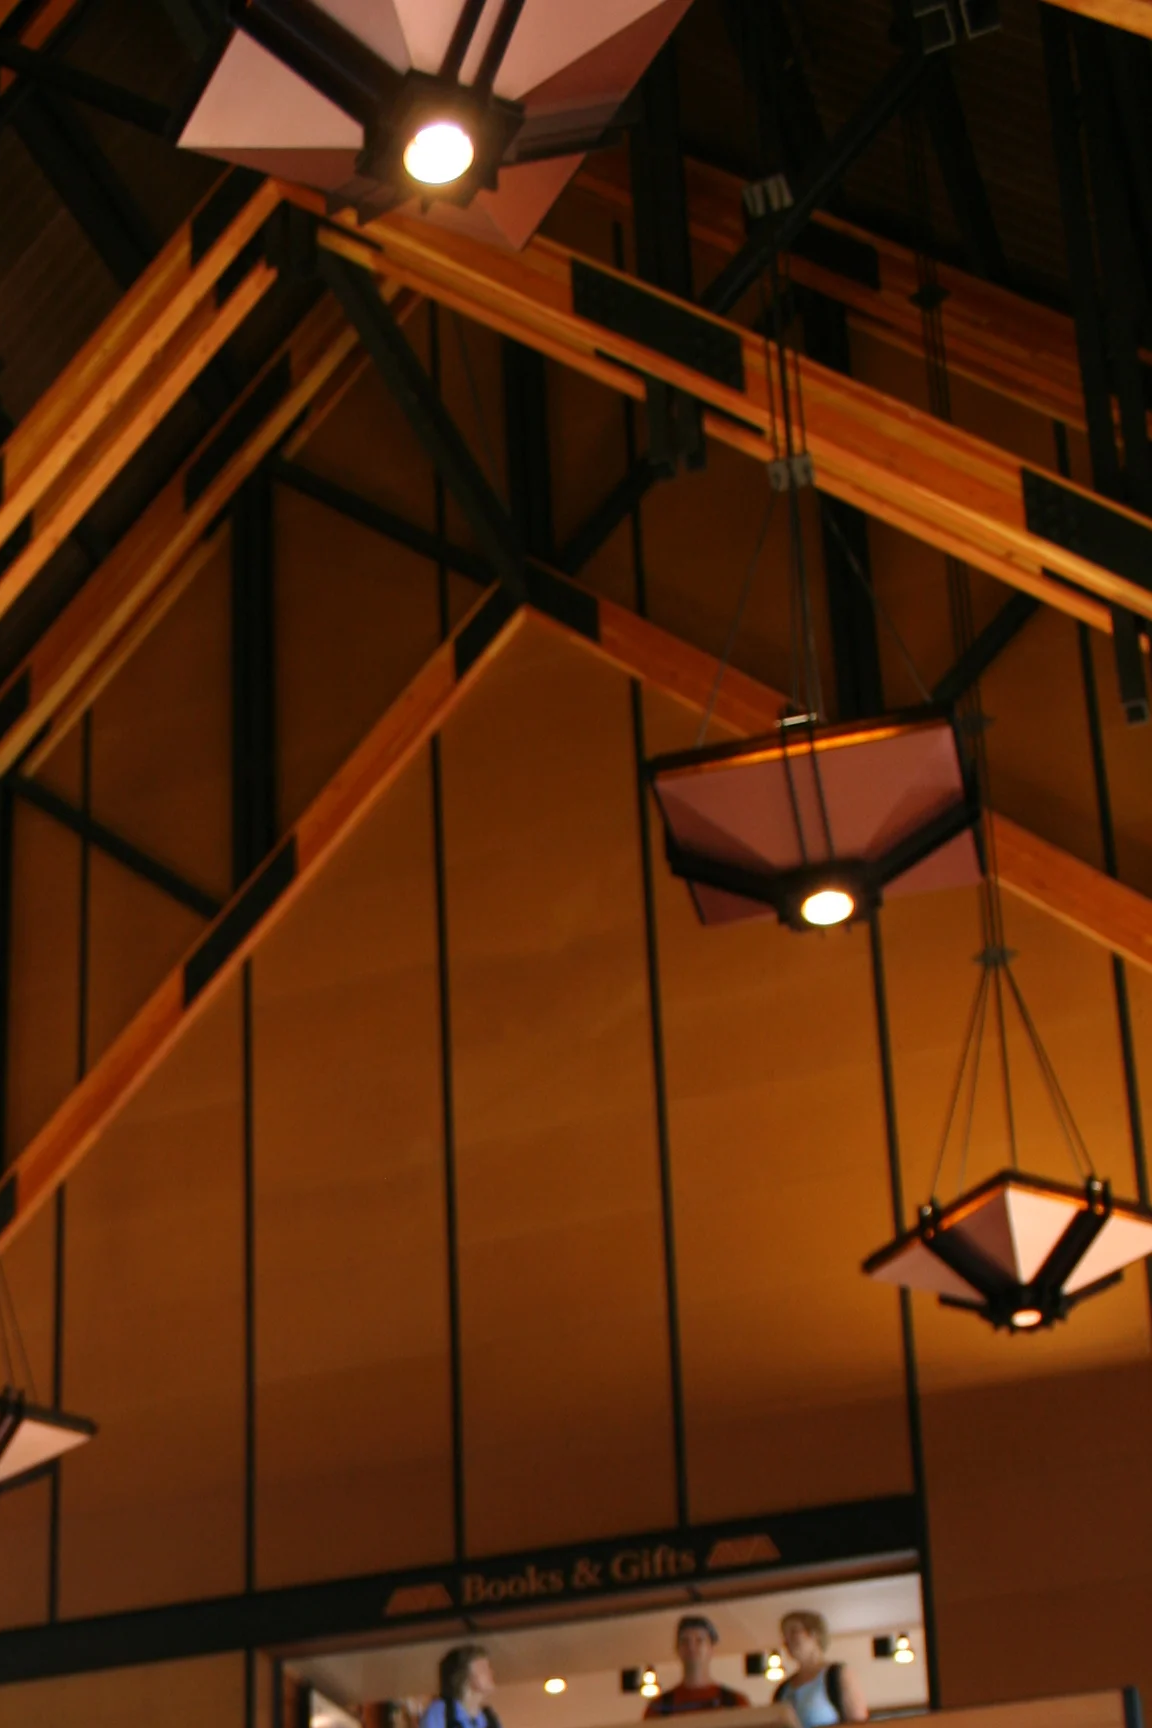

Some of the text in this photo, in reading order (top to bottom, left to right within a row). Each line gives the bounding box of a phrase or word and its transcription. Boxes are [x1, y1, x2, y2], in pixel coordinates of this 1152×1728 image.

[462, 1545, 696, 1605] Books & Gifts
